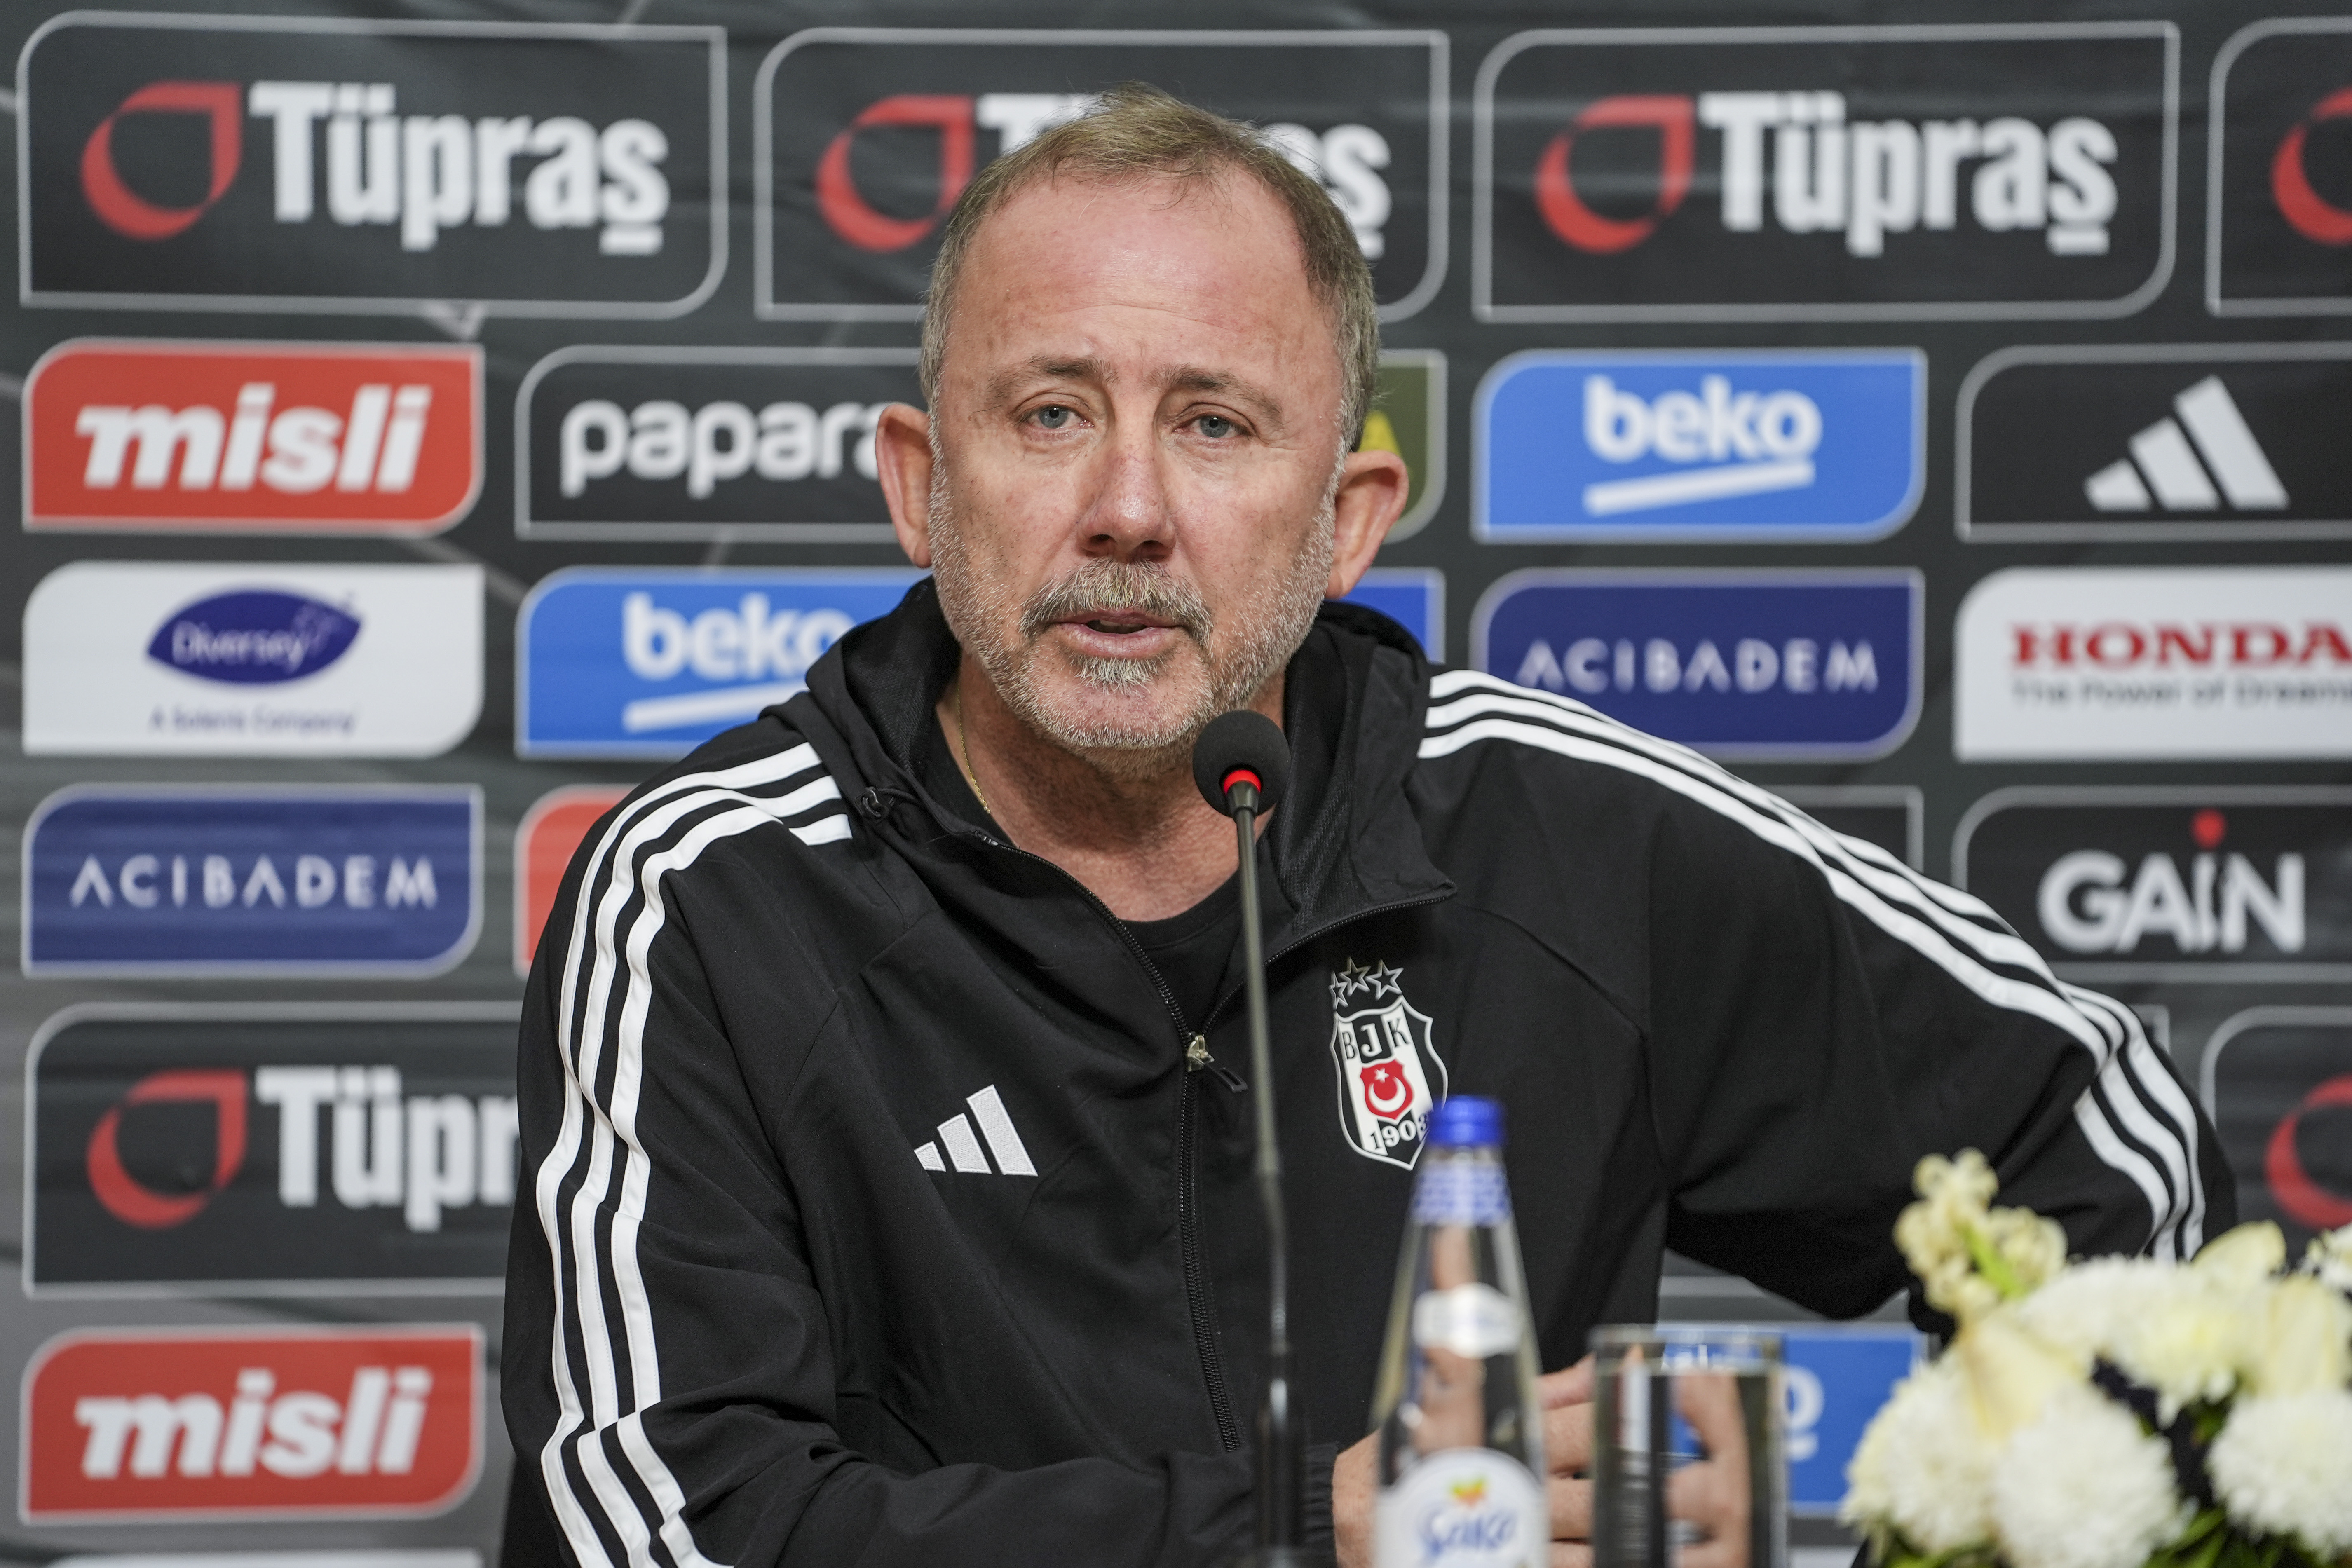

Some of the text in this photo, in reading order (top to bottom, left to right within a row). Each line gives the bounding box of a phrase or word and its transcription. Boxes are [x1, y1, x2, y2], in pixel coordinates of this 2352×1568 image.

[249, 80, 670, 255] Tüpraş
[1697, 91, 2118, 256] Tüpraş
[75, 383, 432, 493] misli
[1584, 375, 1823, 462] beko
[622, 591, 857, 681] beko
[1517, 639, 1878, 693] ACIBADEM
[2012, 621, 2352, 669] HONDA
[71, 855, 438, 908] ACIBADEM
[1342, 1018, 1411, 1061] BJK
[255, 1066, 521, 1231] Tüpr
[1369, 1113, 1429, 1150] 1903
[75, 1366, 433, 1479] misli
